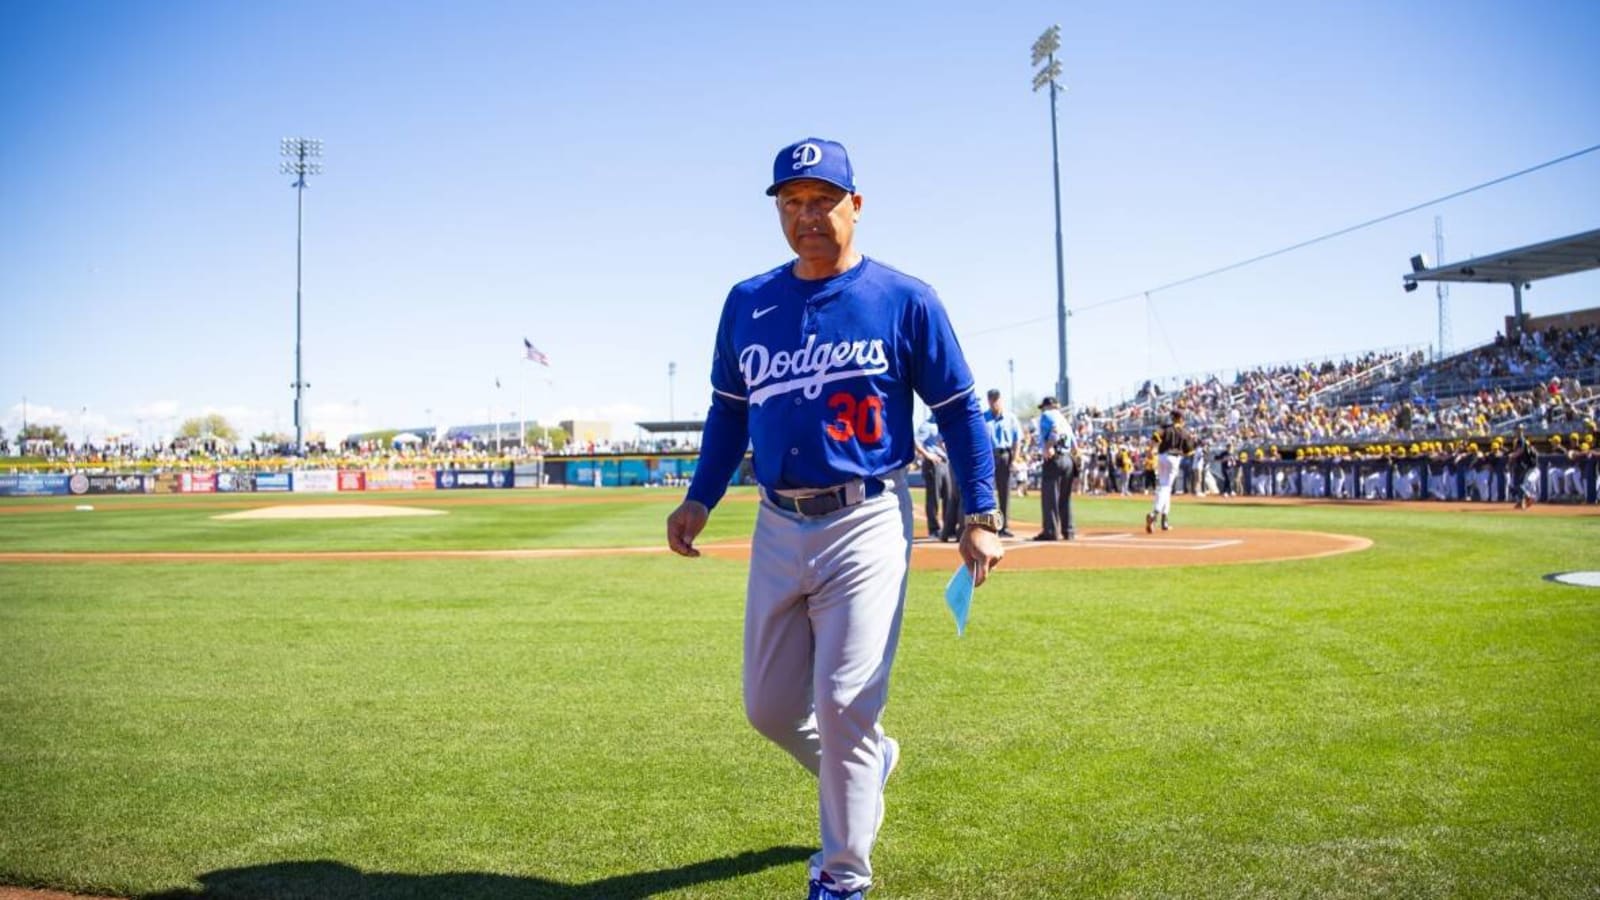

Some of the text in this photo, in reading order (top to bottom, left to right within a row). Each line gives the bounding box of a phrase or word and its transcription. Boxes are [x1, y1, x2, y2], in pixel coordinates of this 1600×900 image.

[792, 143, 822, 170] D
[739, 334, 889, 405] Dodgers
[826, 392, 883, 443] 30
